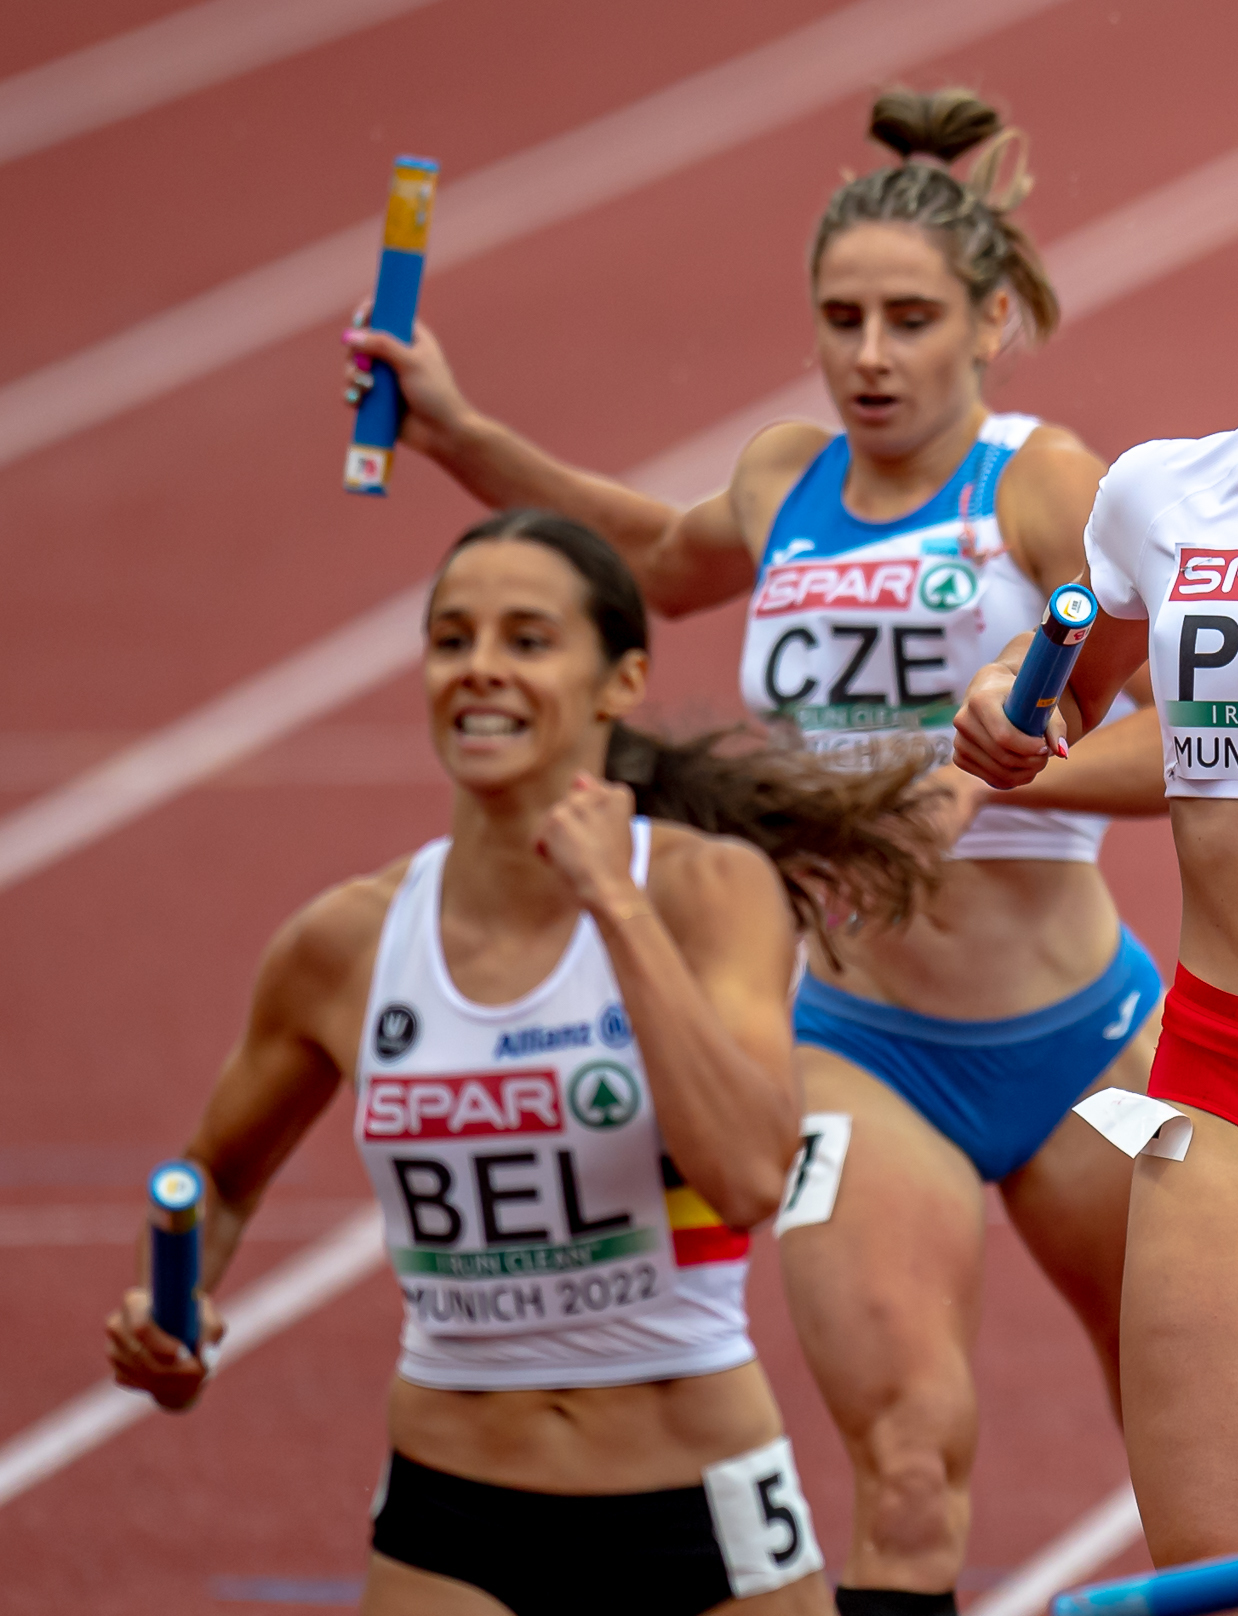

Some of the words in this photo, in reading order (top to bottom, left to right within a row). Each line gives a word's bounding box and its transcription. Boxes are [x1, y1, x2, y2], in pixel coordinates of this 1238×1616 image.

[758, 566, 914, 611] SPAR
[764, 625, 954, 706] CZE
[1212, 704, 1217, 725] I
[494, 1023, 592, 1060] Allianz
[367, 1073, 560, 1136] SPAR
[393, 1148, 631, 1247] BEL
[556, 1261, 657, 1317] 2022
[757, 1473, 800, 1566] 5
